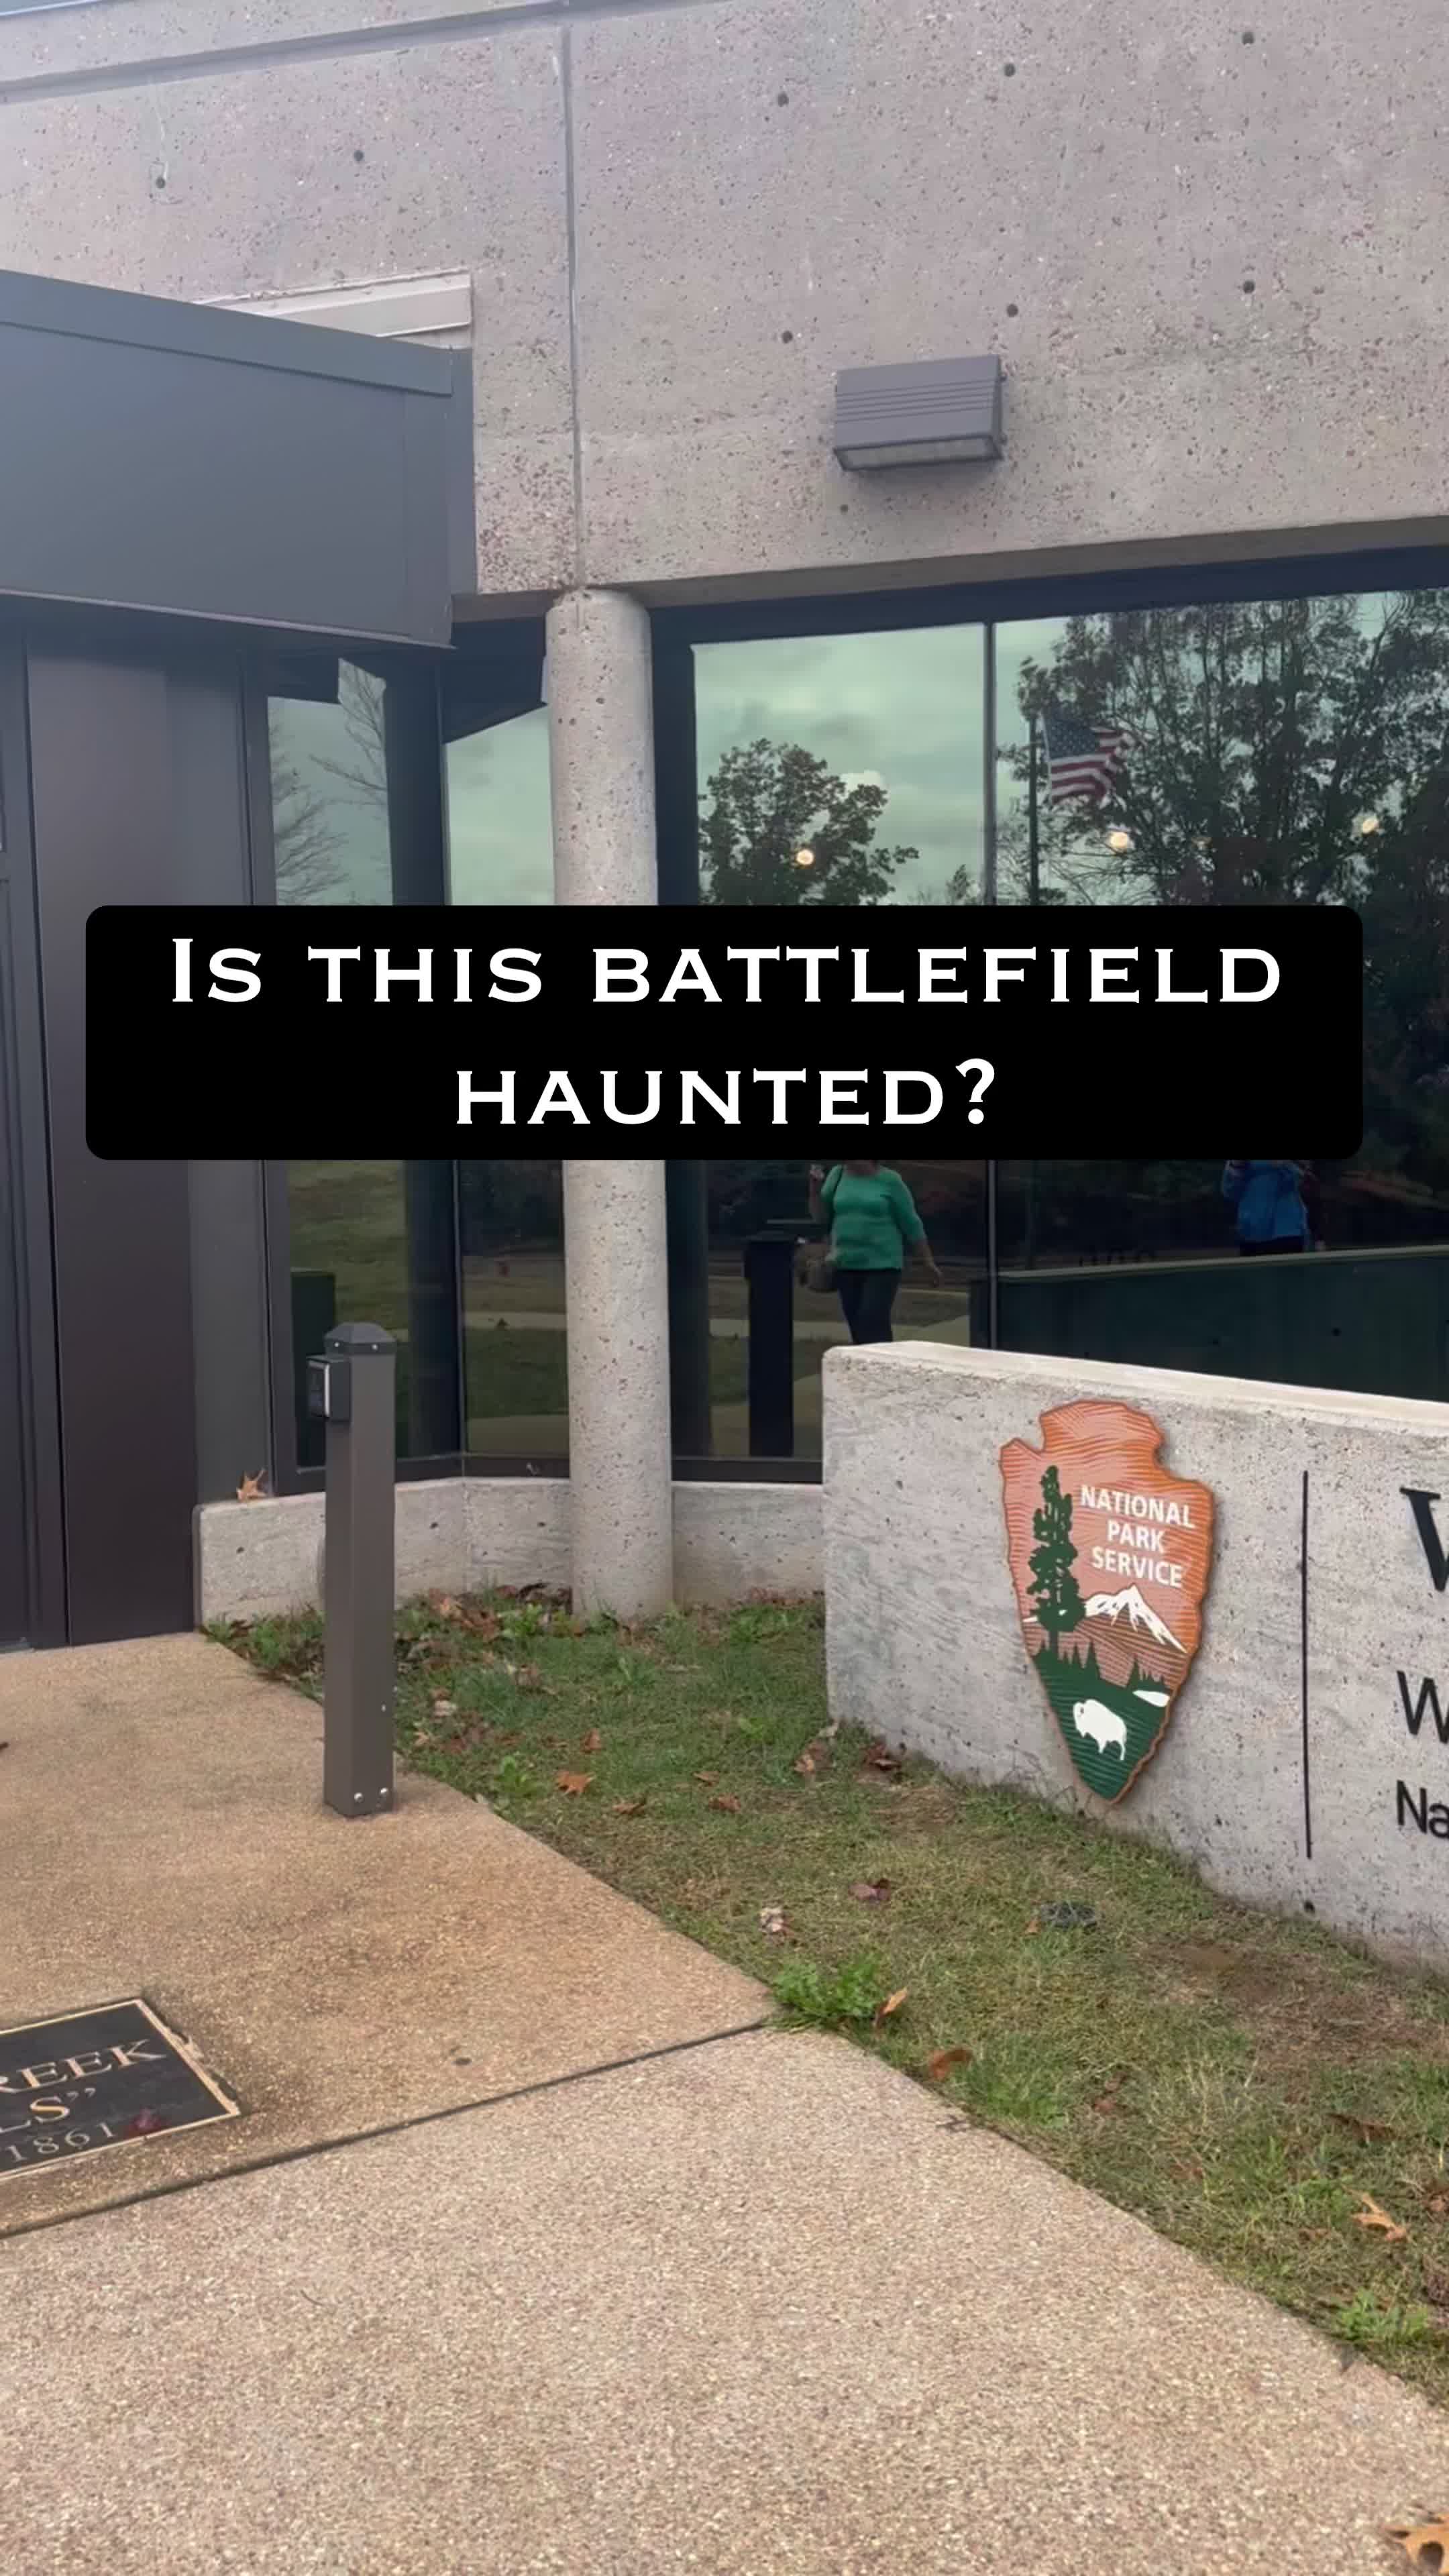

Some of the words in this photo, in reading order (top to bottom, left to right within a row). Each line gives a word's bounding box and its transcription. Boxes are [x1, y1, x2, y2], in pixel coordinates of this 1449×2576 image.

[1079, 1485, 1196, 1529] NATIONAL
[1108, 1519, 1165, 1554] PARK
[1091, 1546, 1183, 1589] SERVICE
[5, 2122, 115, 2163] 1861
